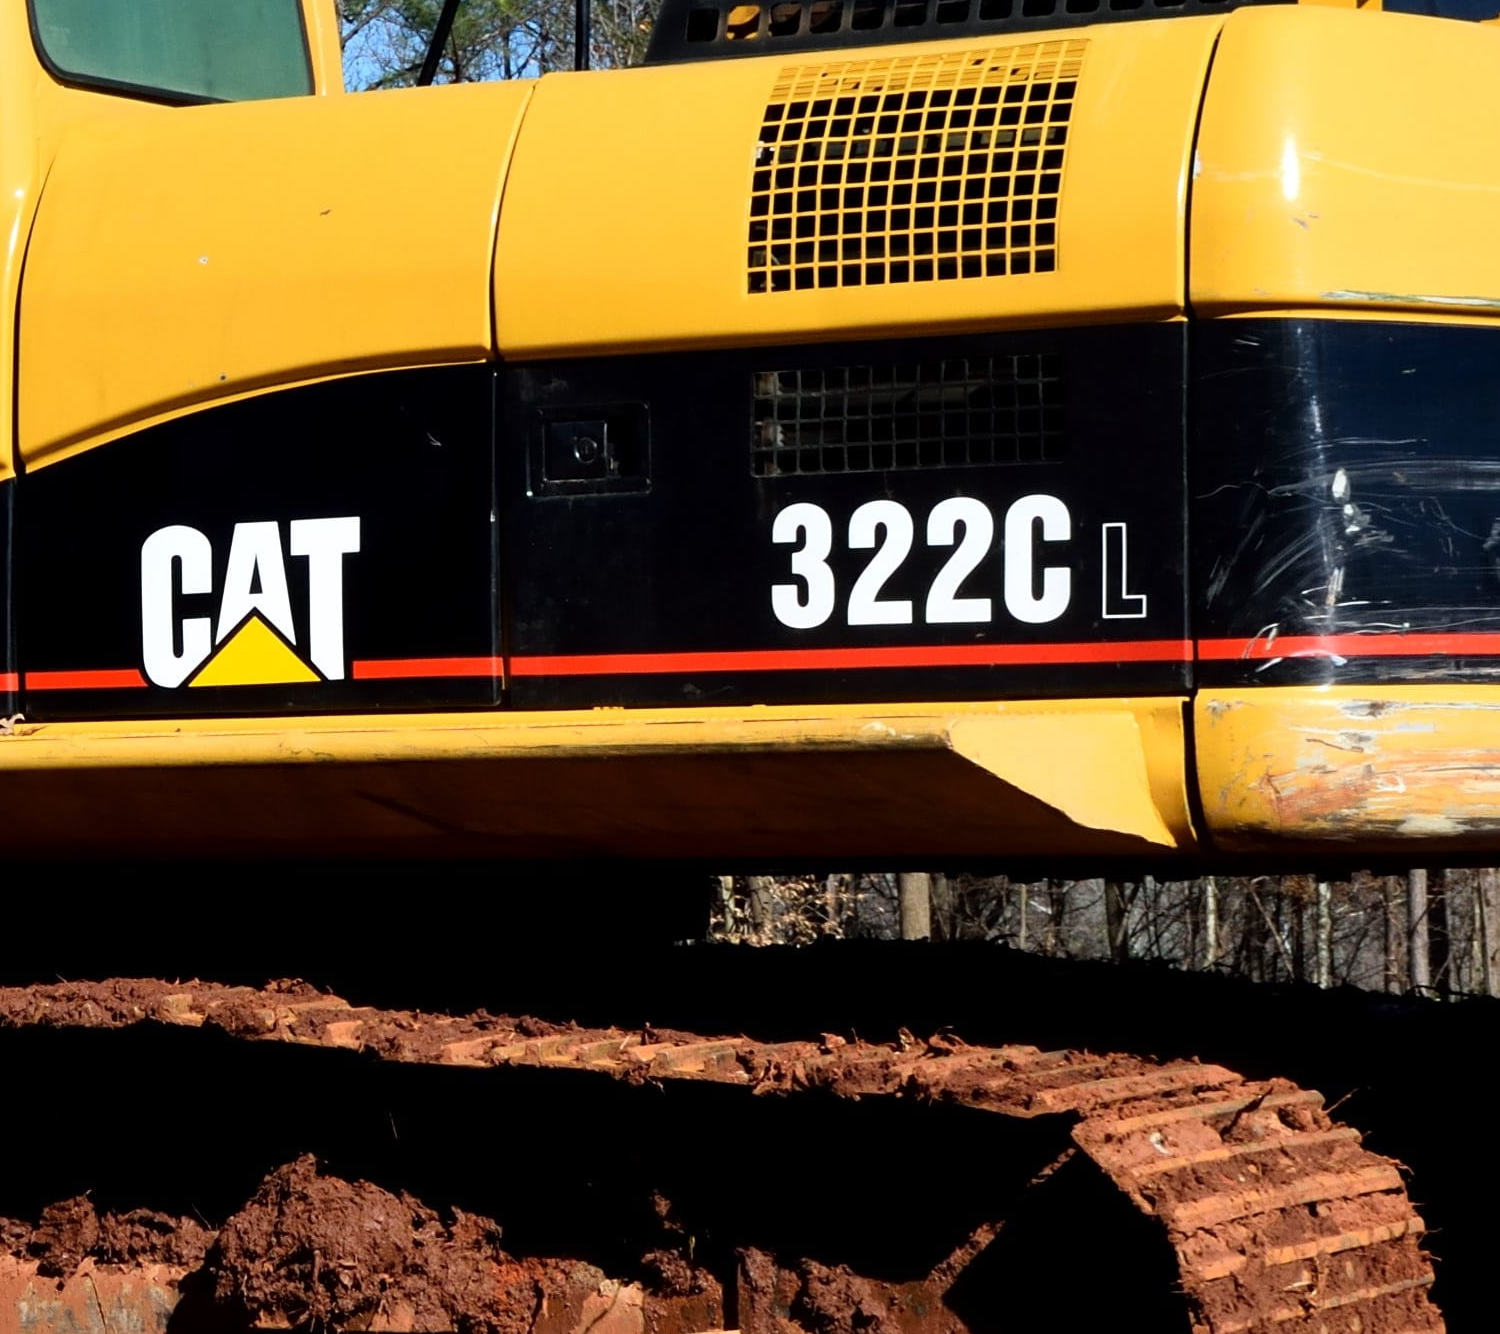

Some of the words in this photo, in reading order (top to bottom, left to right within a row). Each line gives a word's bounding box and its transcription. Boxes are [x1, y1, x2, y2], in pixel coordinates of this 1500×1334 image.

[140, 515, 361, 689] CAT
[770, 493, 1072, 629] 322C
[1102, 522, 1147, 619] L
